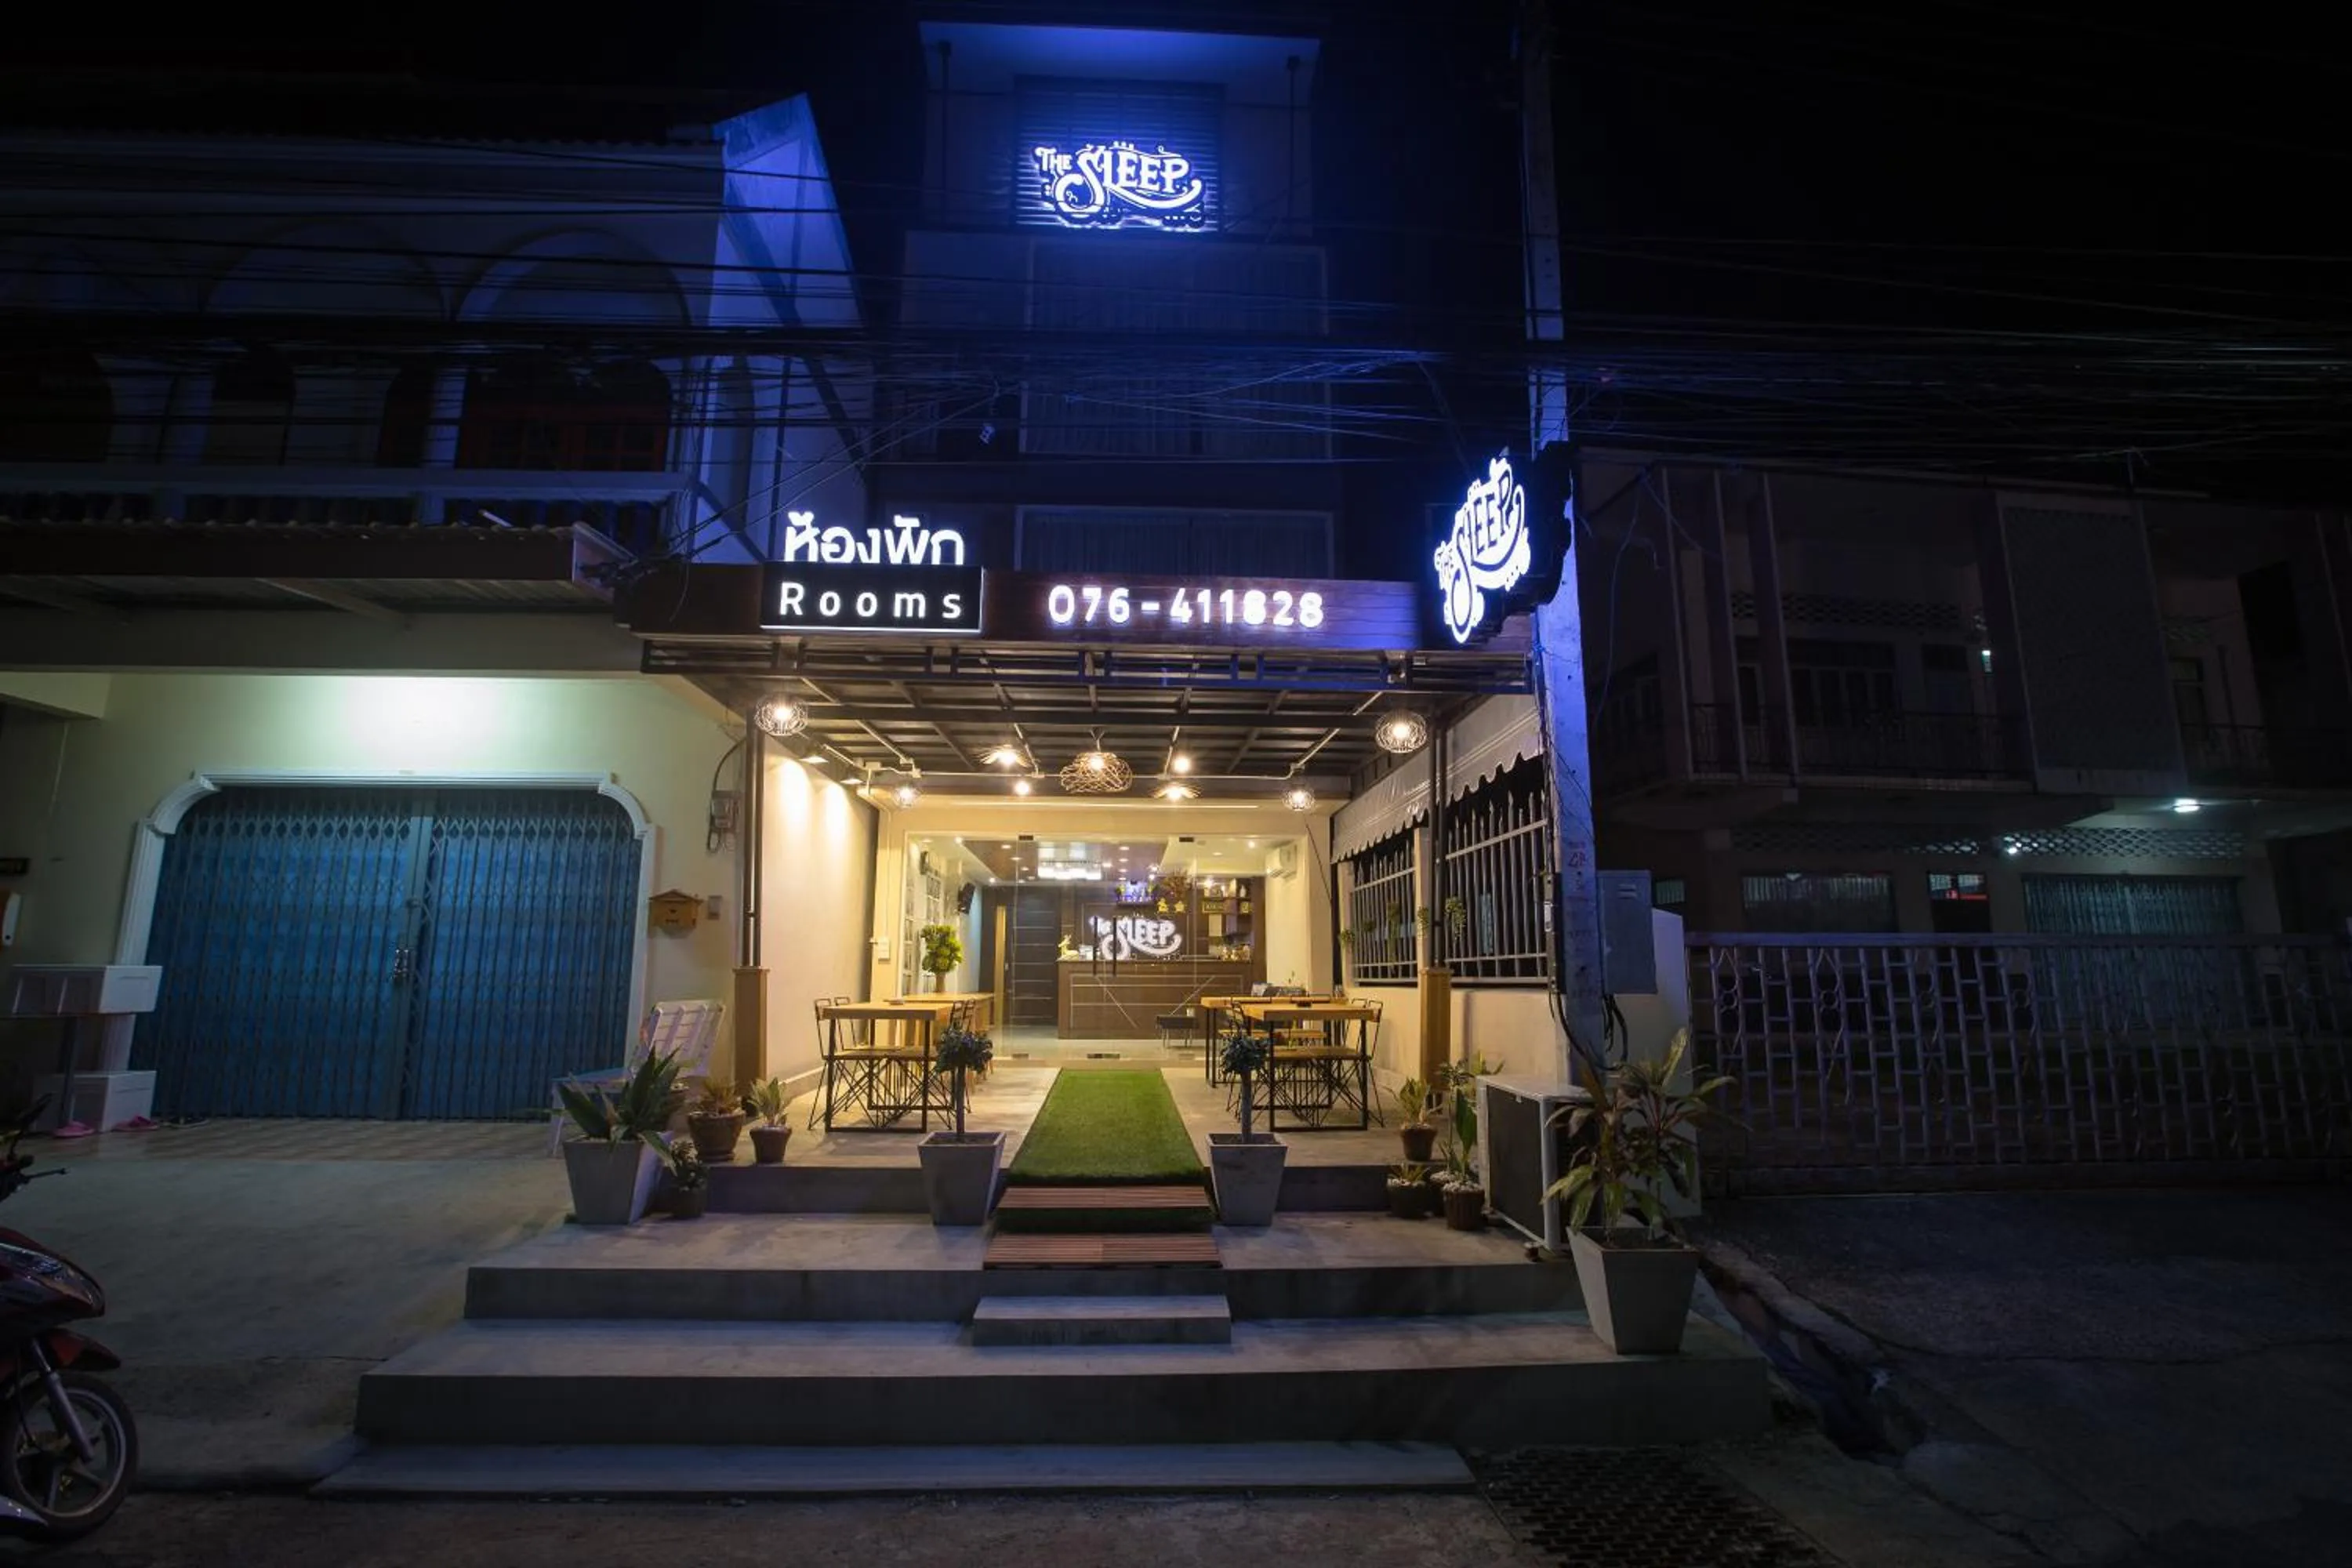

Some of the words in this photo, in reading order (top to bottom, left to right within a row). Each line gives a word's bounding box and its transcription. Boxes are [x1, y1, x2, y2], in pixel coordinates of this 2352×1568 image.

[1054, 146, 1203, 213] SLEEP
[785, 511, 964, 564] ห้องพัก
[779, 582, 962, 619] Rooms
